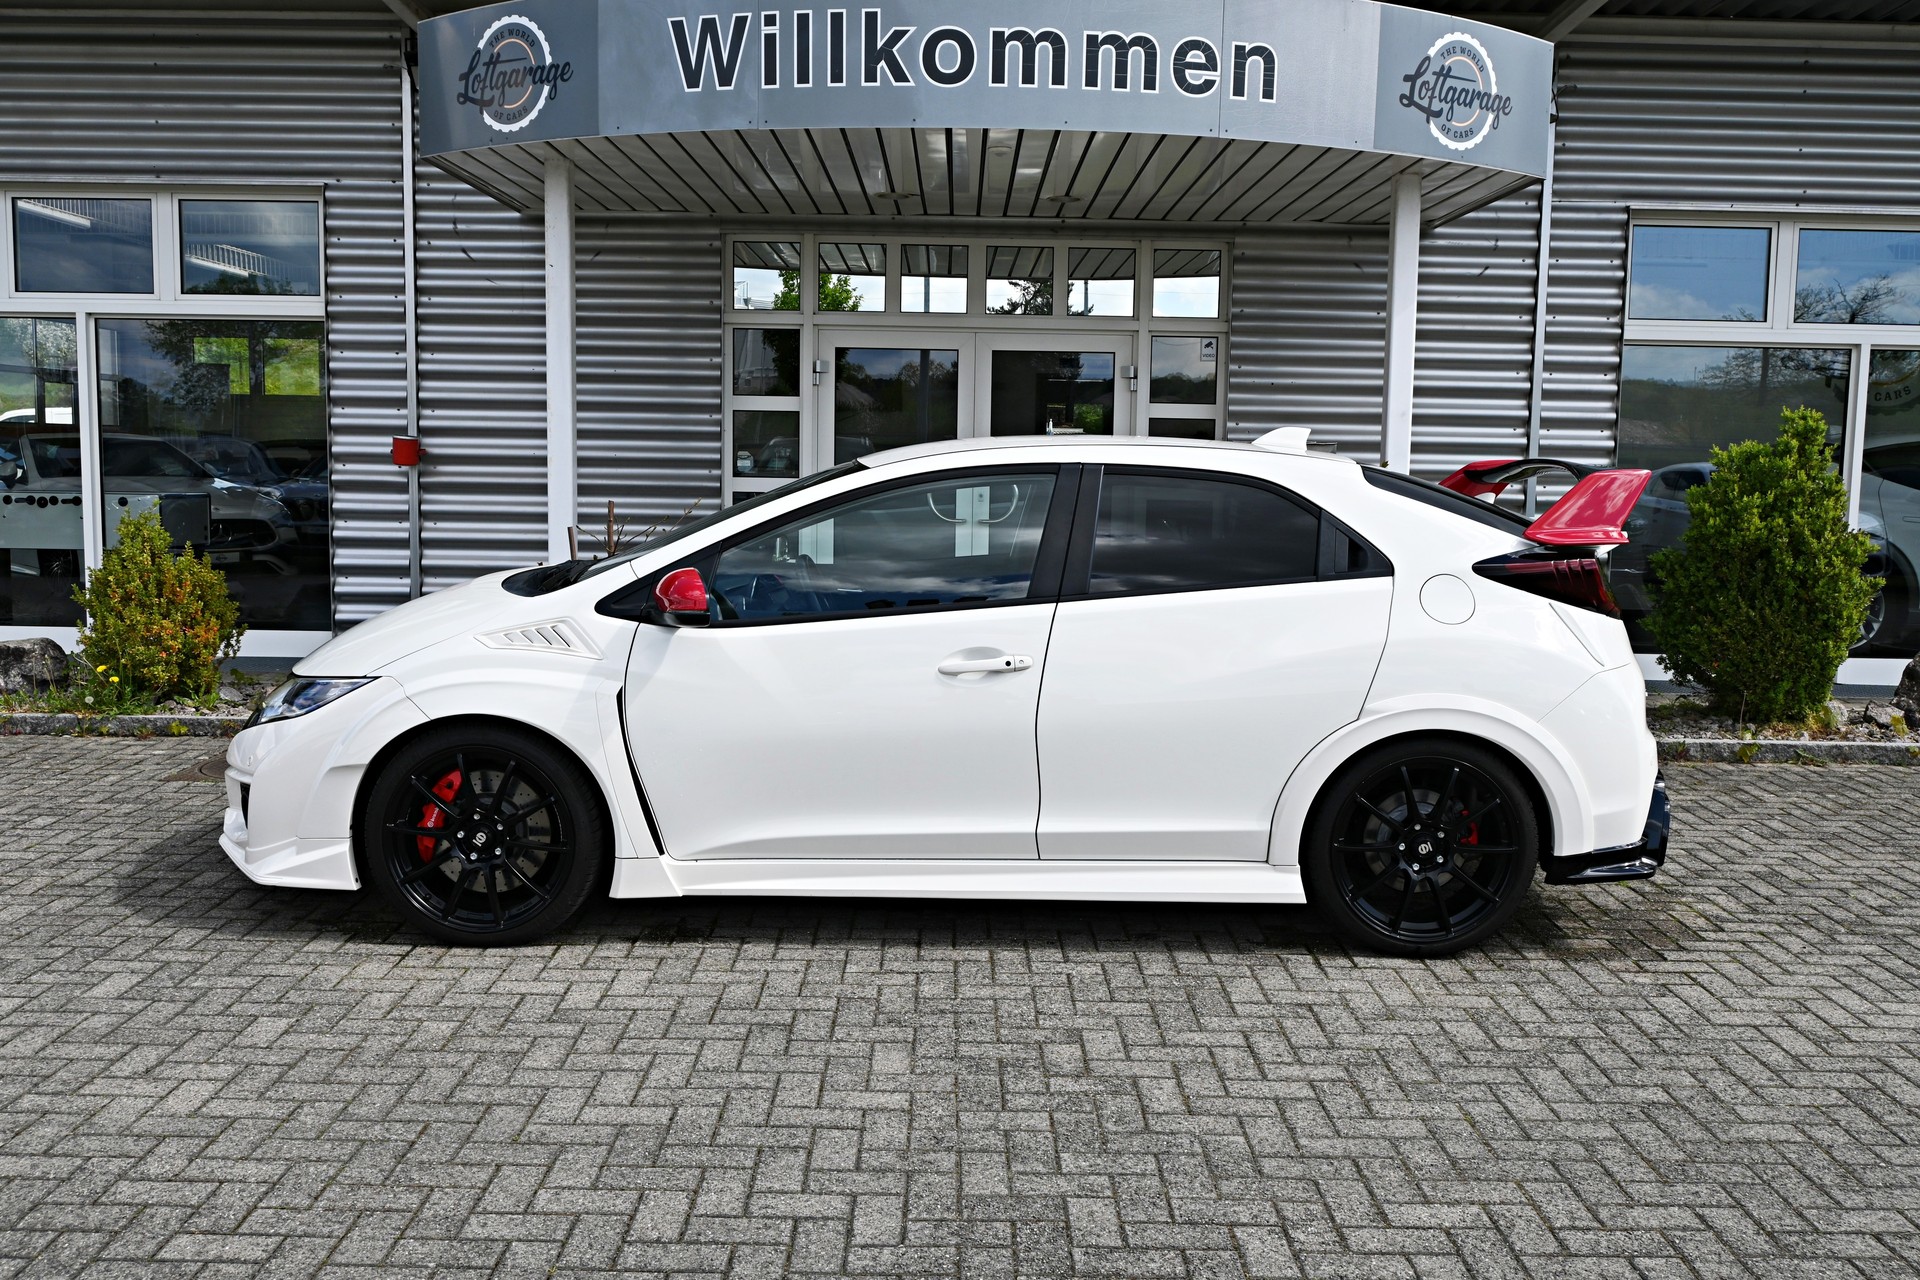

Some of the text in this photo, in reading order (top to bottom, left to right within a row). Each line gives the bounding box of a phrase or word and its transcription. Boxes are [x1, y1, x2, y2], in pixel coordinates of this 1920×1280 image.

[489, 28, 536, 48] THE WORLD
[667, 8, 1277, 104] Willkommen
[1440, 46, 1485, 73] THE WORLD
[456, 49, 574, 116] Loftgarage
[1399, 55, 1513, 130] Loftgarage
[493, 105, 529, 121] OF CARS
[1441, 123, 1475, 139] OF CARS
[1874, 385, 1912, 402] CARS
